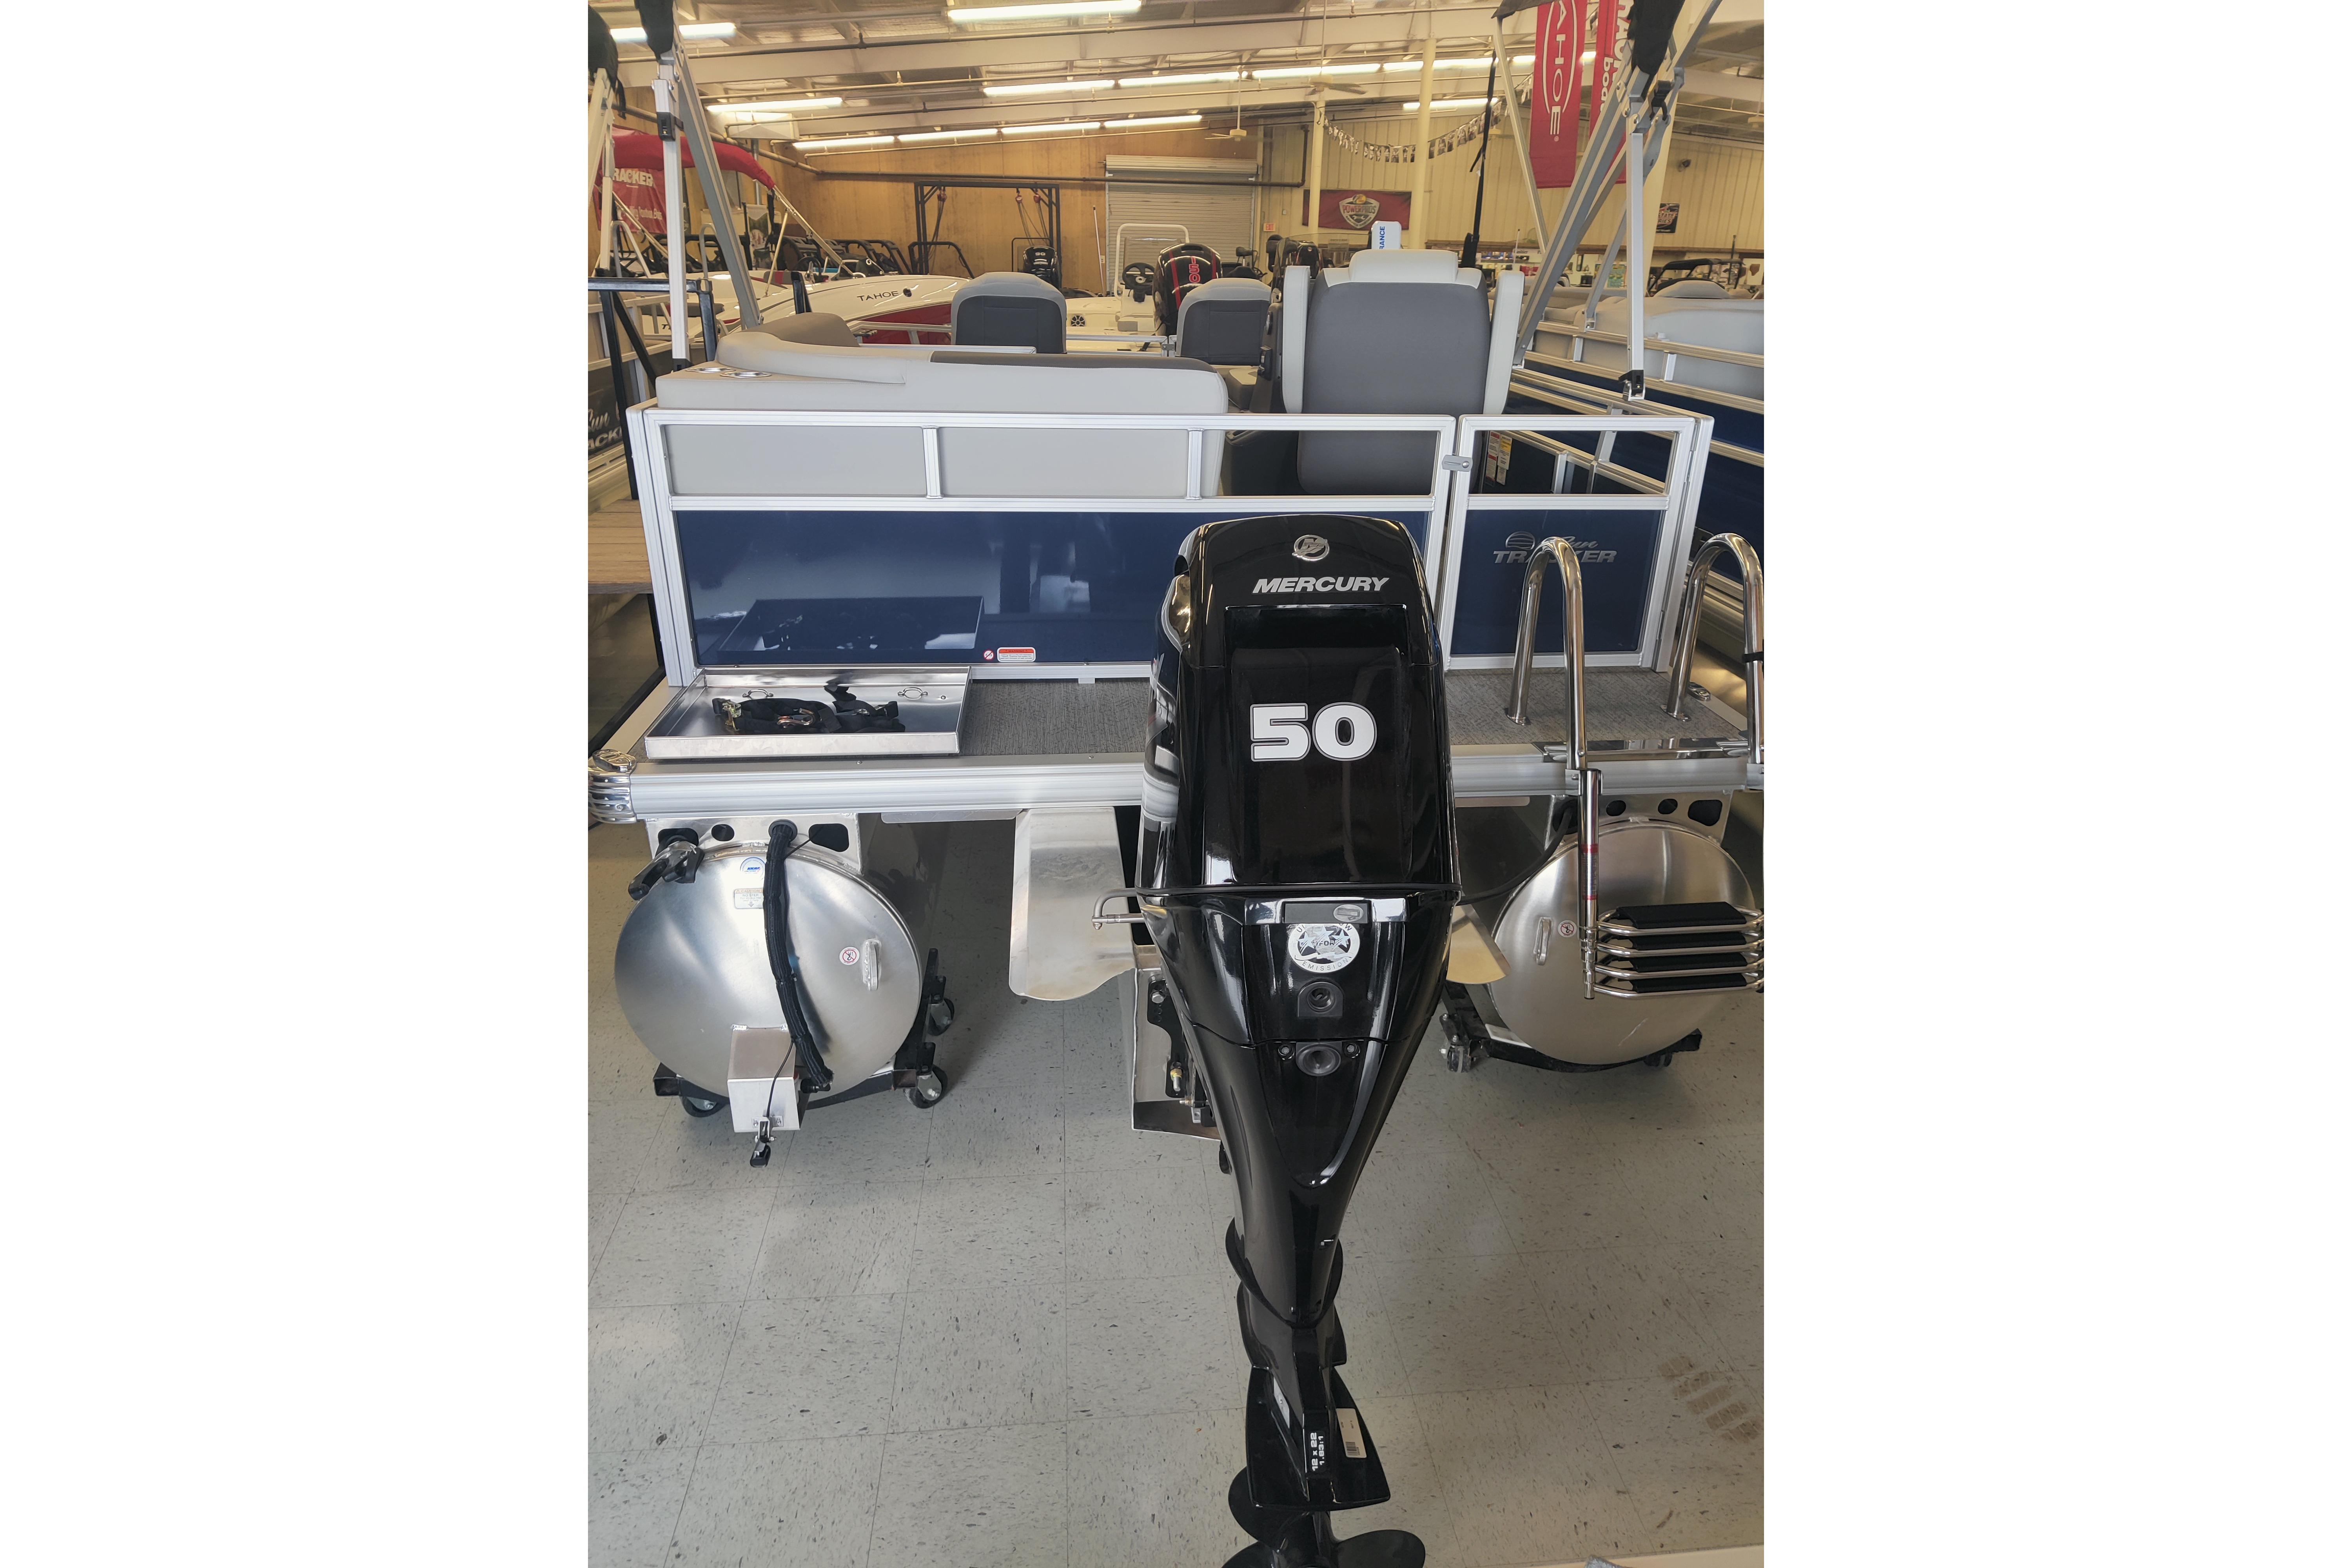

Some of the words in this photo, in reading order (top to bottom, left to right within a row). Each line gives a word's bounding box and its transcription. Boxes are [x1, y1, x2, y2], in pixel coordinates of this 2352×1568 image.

[1189, 256, 1200, 283] 150
[857, 290, 898, 301] TAHOE
[1493, 550, 1617, 564] TRER
[1252, 577, 1390, 593] MERCURY
[1250, 702, 1377, 762] 50
[1302, 958, 1349, 971] EMISSION
[1310, 1432, 1317, 1448] 22
[1312, 1458, 1318, 1471] 12
